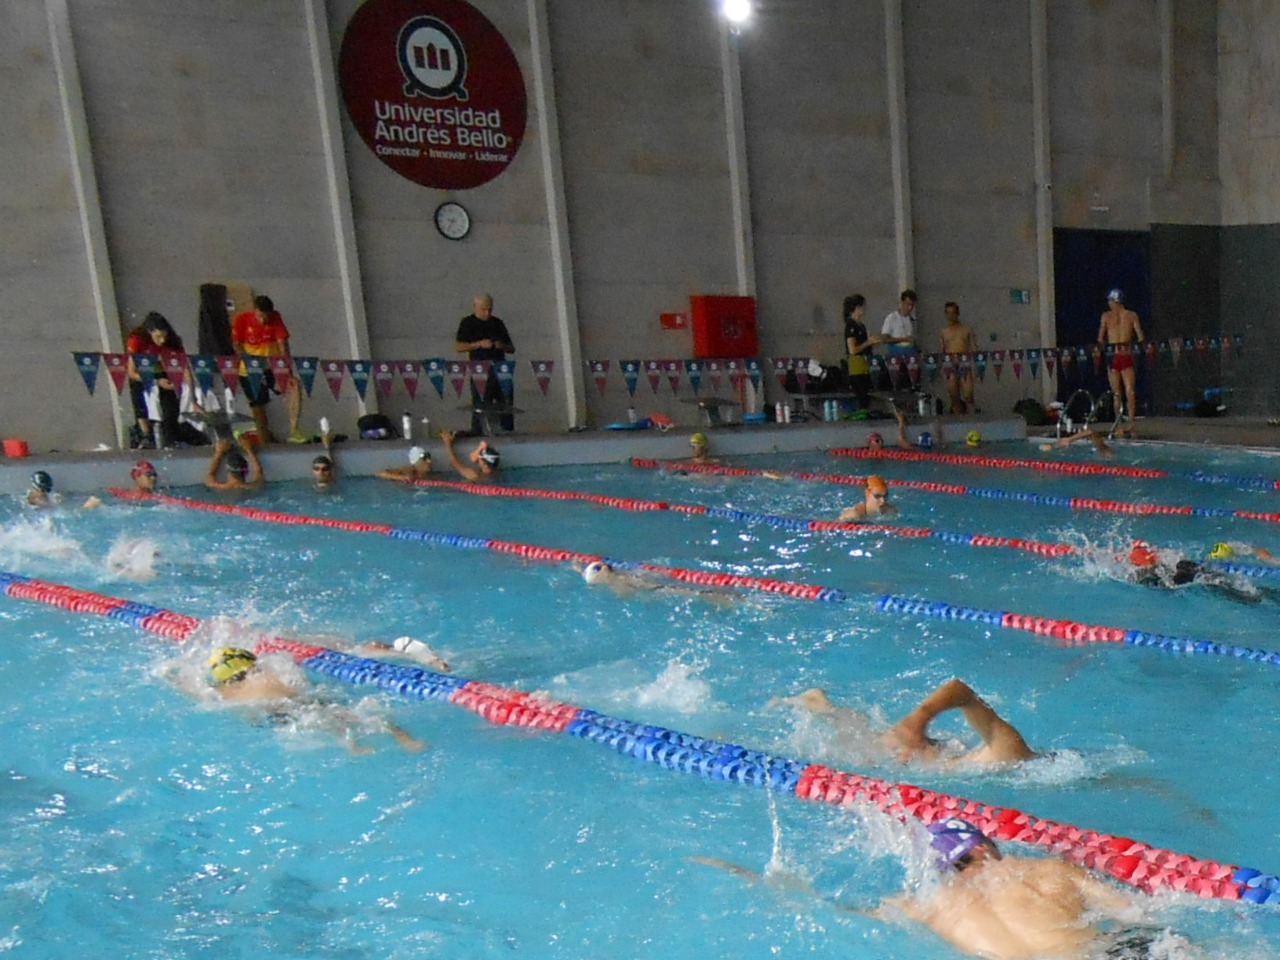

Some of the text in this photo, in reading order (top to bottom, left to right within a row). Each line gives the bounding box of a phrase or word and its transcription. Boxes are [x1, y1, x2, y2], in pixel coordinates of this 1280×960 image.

[374, 100, 501, 128] Universidad
[375, 120, 507, 149] Andrés Bello
[376, 144, 508, 162] Conectar Innovar Liderar
